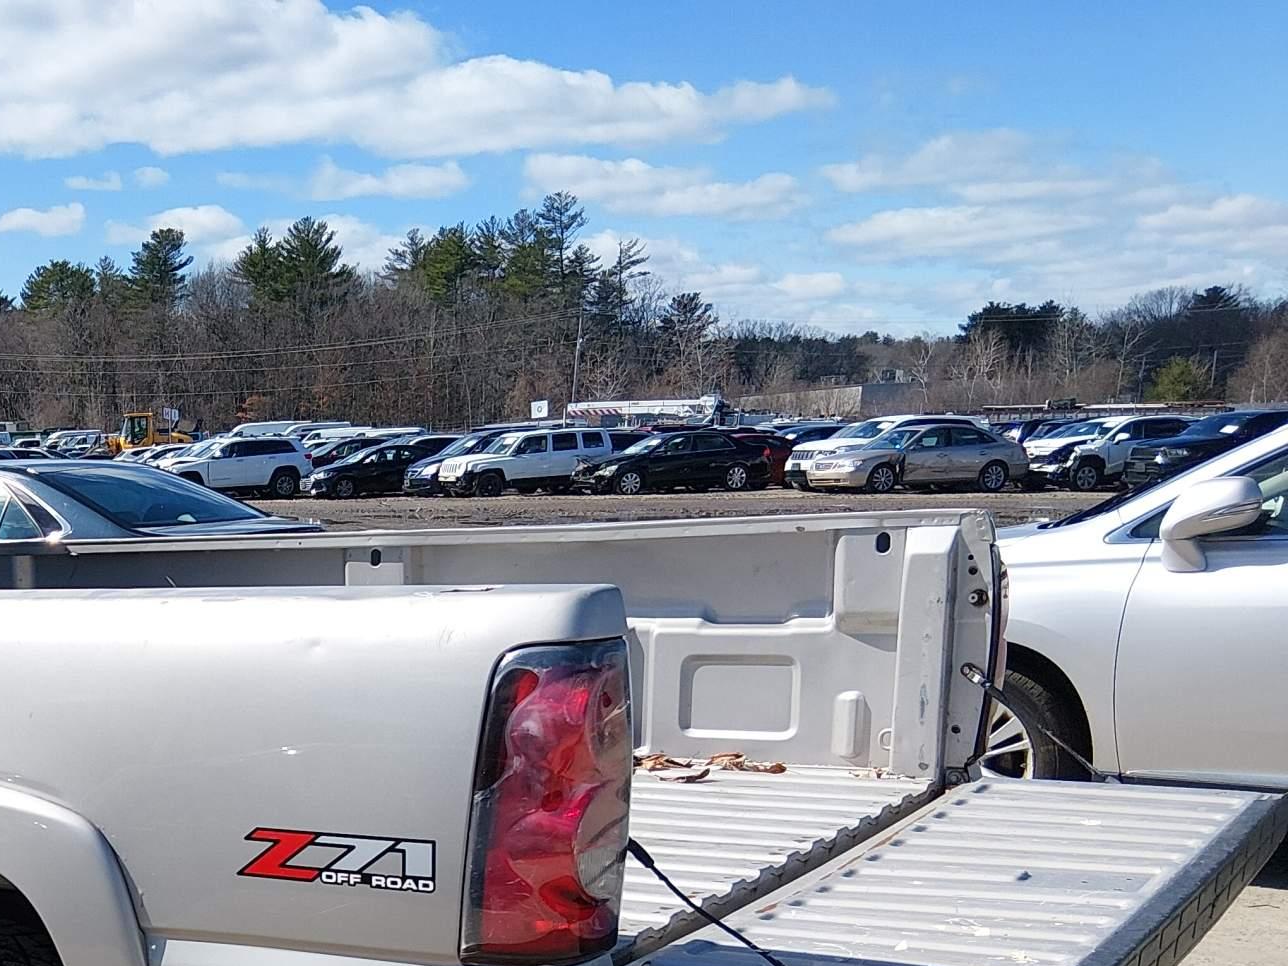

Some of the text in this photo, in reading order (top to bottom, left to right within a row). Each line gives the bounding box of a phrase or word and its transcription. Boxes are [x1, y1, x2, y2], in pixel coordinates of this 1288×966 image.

[236, 826, 437, 882] Z71
[320, 871, 435, 892] OFF ROAD
